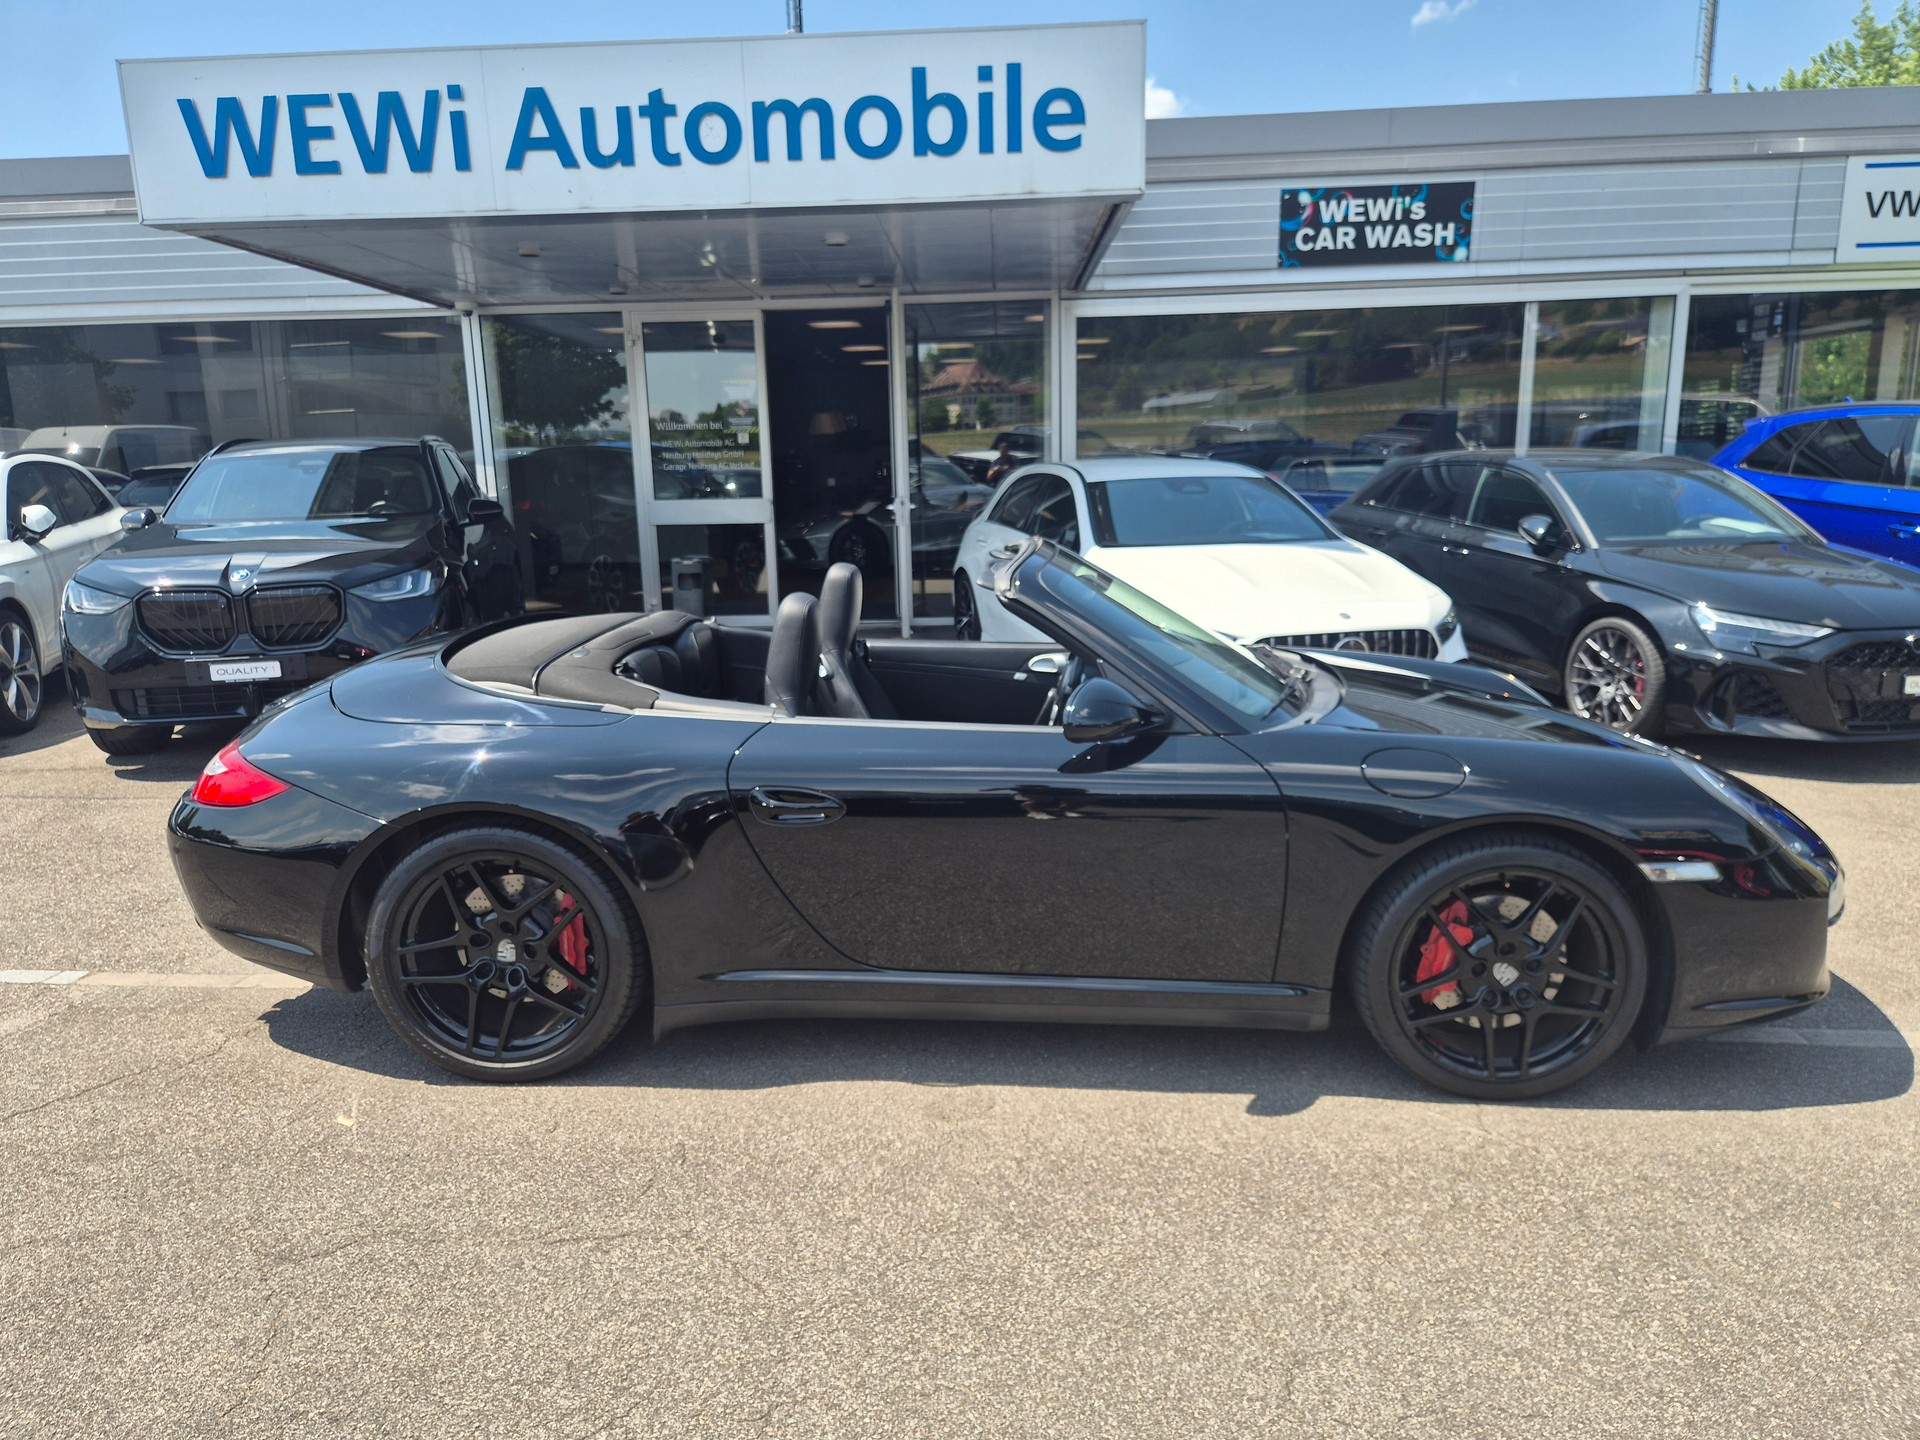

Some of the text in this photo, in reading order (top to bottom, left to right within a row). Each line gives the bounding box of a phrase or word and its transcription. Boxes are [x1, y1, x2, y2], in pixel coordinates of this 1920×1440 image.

[177, 62, 1086, 180] WEWi Automobile
[1319, 196, 1427, 224] WEWi's
[1295, 222, 1456, 252] CAR WASH
[656, 421, 723, 431] Willkommen bei
[685, 439, 723, 448] Automobile
[725, 438, 735, 447] AG
[723, 450, 745, 459] GmbH
[663, 463, 687, 472] Garage
[216, 666, 268, 676] QUALITY
